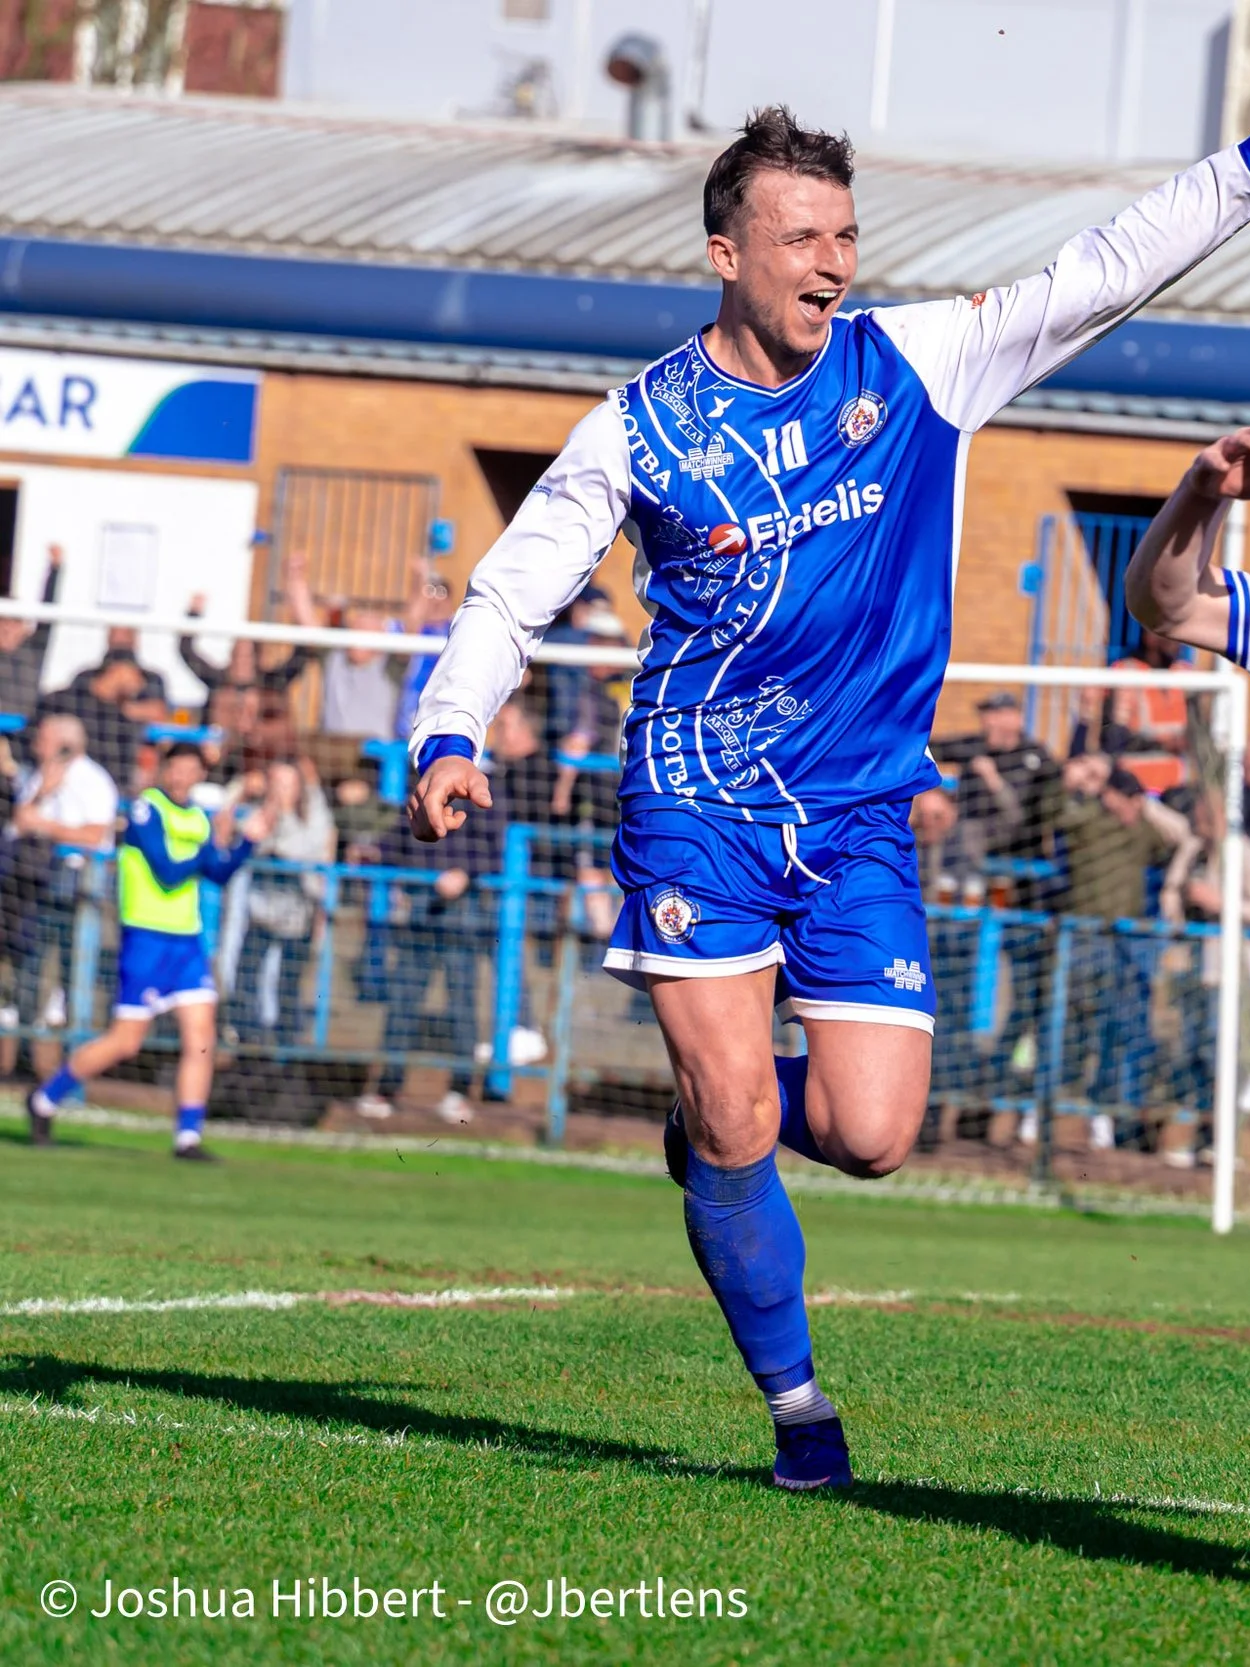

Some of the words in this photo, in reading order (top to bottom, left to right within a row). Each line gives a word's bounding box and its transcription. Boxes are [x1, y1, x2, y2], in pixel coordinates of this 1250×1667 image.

[3, 374, 97, 432] AR
[655, 389, 692, 419] ABSQUE
[684, 425, 705, 444] LAB
[762, 419, 809, 477] 10
[680, 452, 734, 473] MATCHWINNER
[747, 478, 885, 554] Fidelis
[708, 716, 739, 750] ABSQUE
